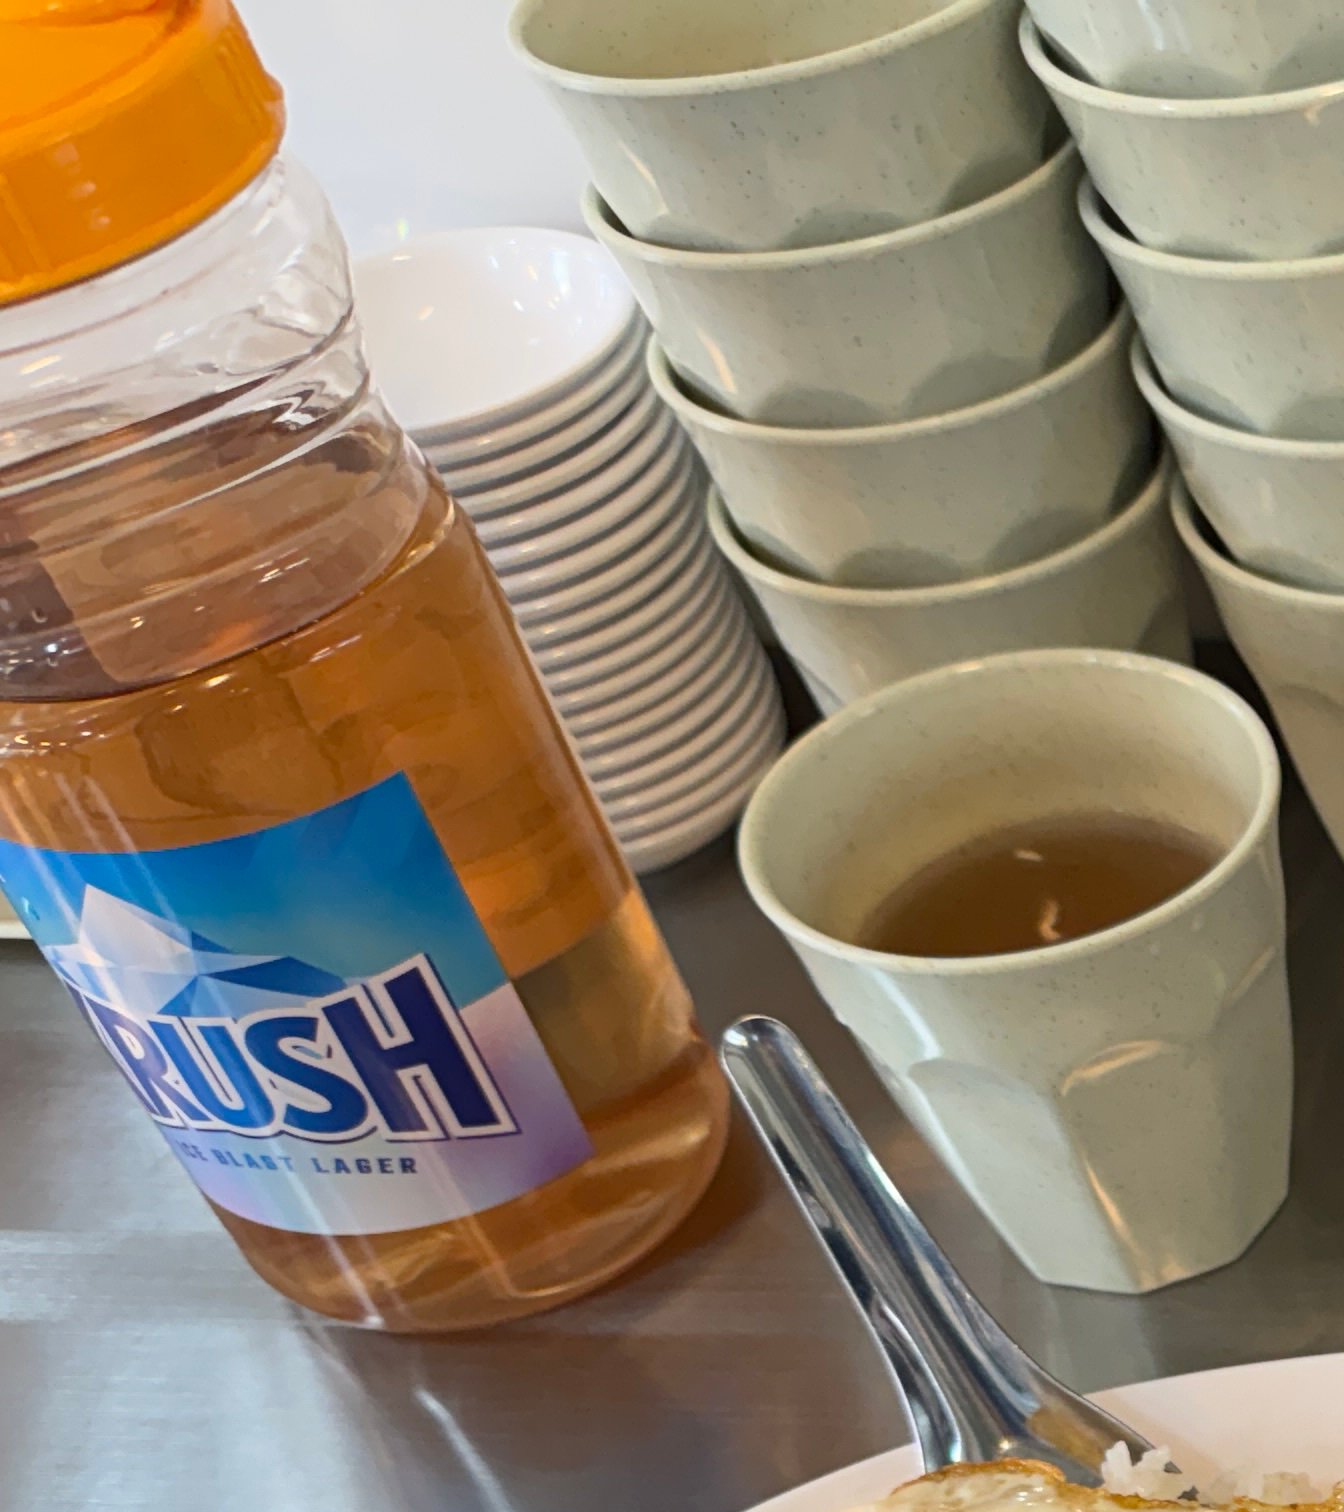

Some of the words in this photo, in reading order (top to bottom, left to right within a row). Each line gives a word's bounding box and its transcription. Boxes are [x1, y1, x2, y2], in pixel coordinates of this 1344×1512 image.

[72, 962, 510, 1138] RUSH
[214, 1147, 294, 1172] BLAST
[311, 1156, 418, 1176] LAGER
